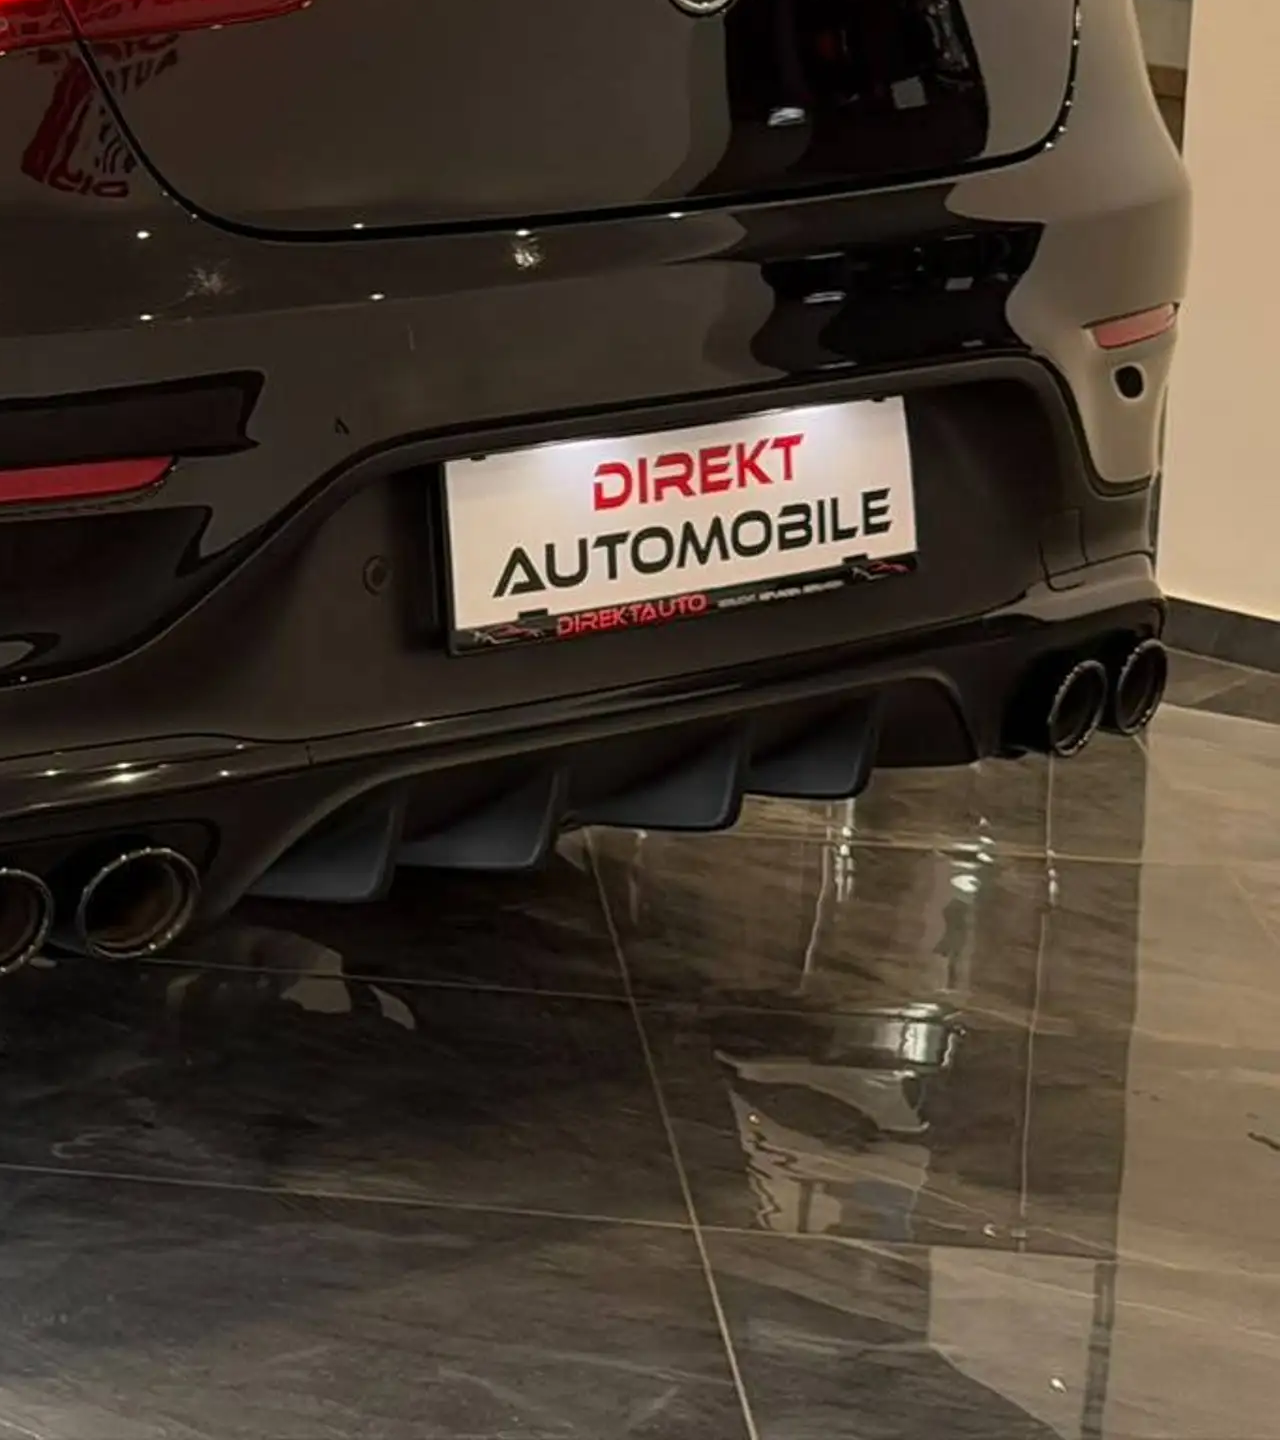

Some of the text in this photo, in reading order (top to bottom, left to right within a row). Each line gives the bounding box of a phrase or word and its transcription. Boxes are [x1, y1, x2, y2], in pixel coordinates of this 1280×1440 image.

[593, 433, 805, 512] DIREKT
[492, 487, 892, 599] AUTOMOBILE
[555, 593, 708, 636] DIREKTAUTO
